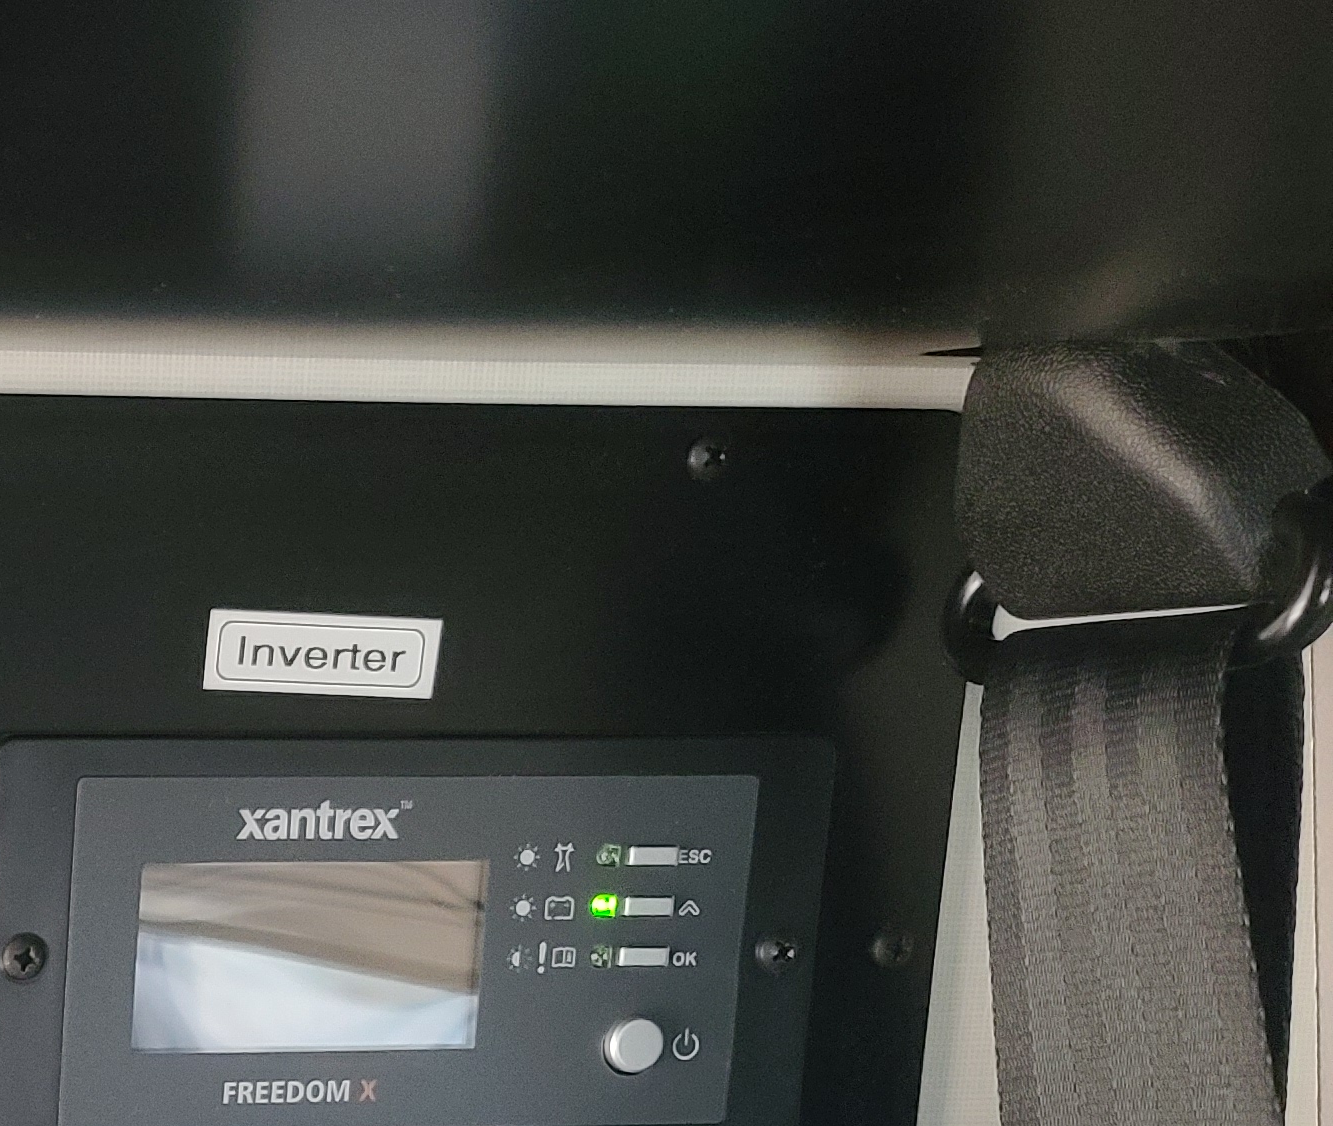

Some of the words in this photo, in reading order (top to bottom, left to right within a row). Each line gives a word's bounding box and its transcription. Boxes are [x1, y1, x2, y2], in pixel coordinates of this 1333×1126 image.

[237, 636, 406, 675] Inverter
[678, 850, 712, 864] ESC
[673, 951, 697, 967] OK
[222, 1081, 350, 1106] FREEDOM
[359, 1079, 377, 1102] X
